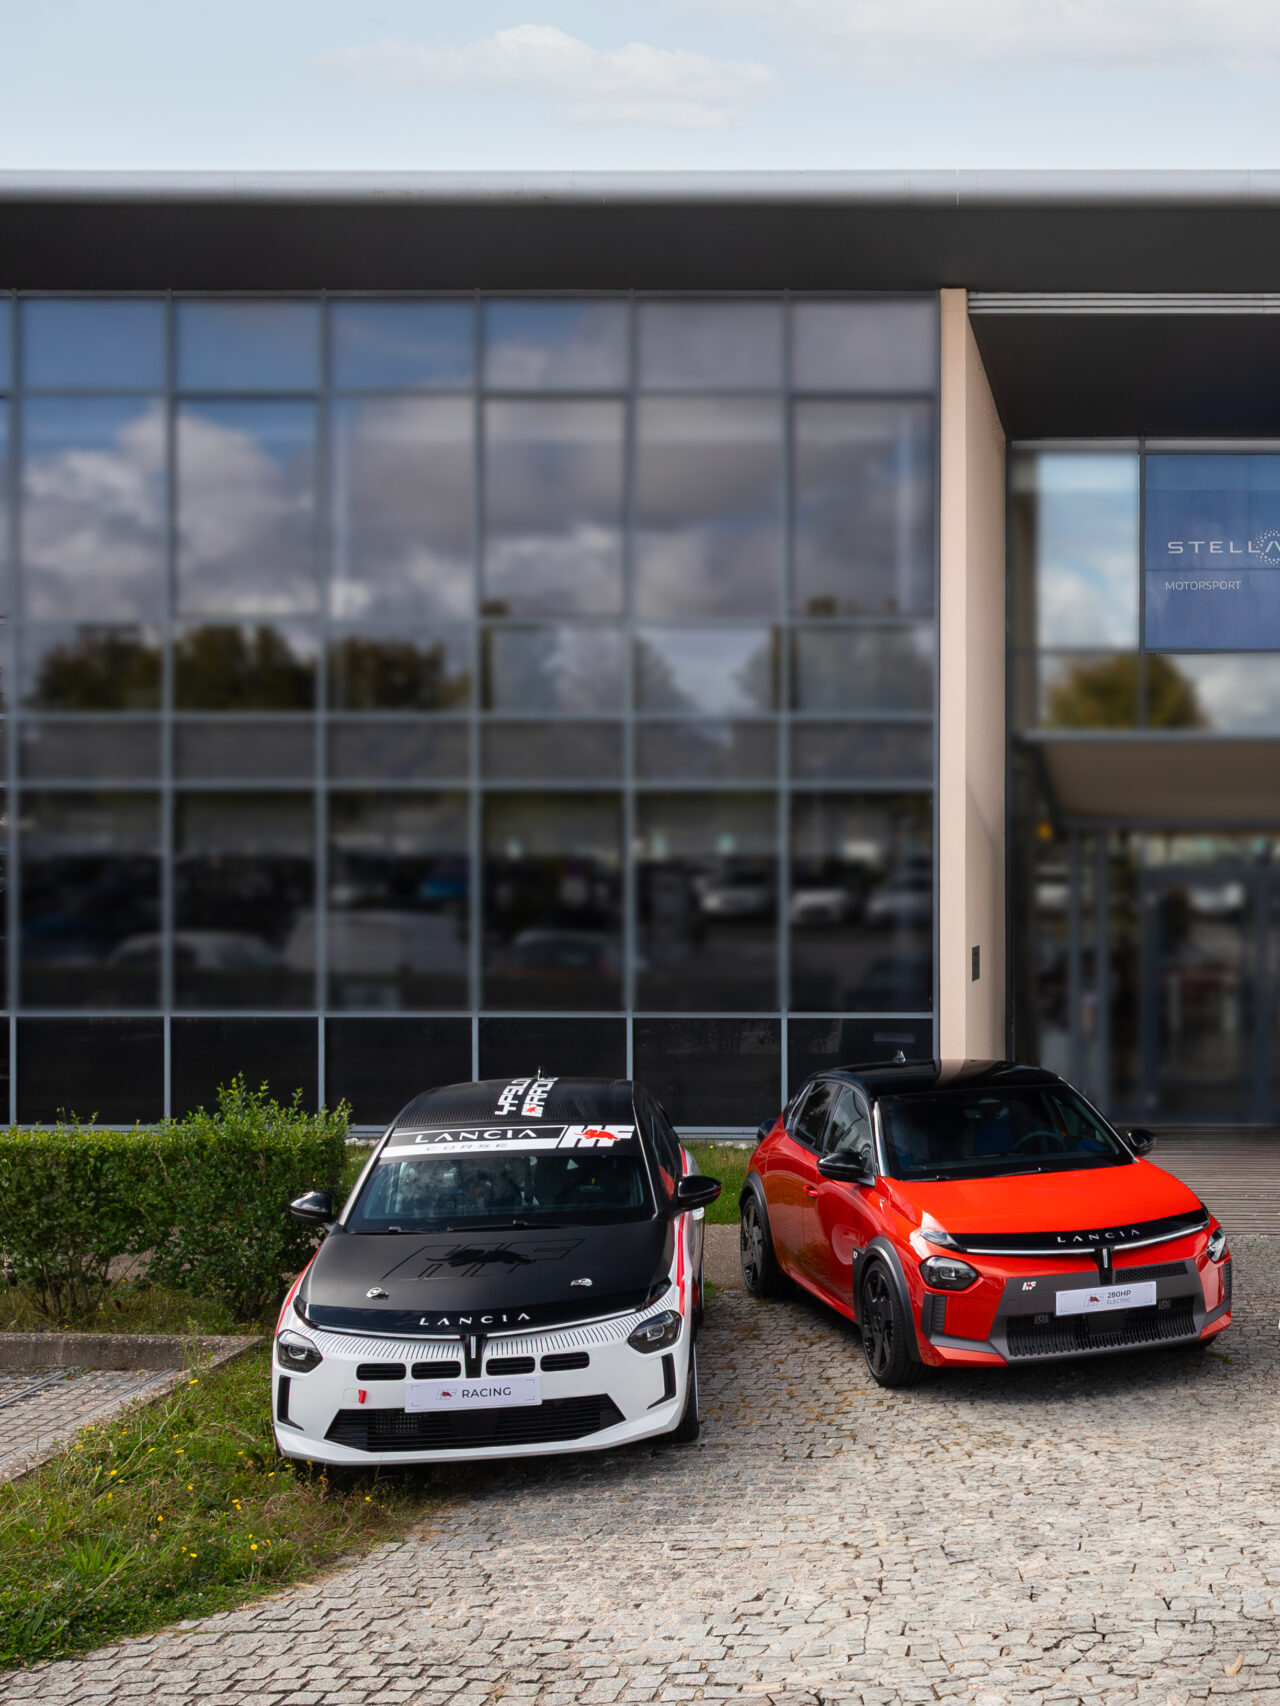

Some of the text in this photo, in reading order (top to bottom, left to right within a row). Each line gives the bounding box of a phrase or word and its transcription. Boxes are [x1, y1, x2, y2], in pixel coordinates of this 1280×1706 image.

[1165, 581, 1242, 591] MOTORSPORT
[415, 1128, 537, 1143] LANCIA
[1057, 1229, 1140, 1242] LANCIA
[1107, 1290, 1131, 1298] 280HP
[419, 1313, 531, 1325] LANCIA
[462, 1387, 512, 1399] RACING
